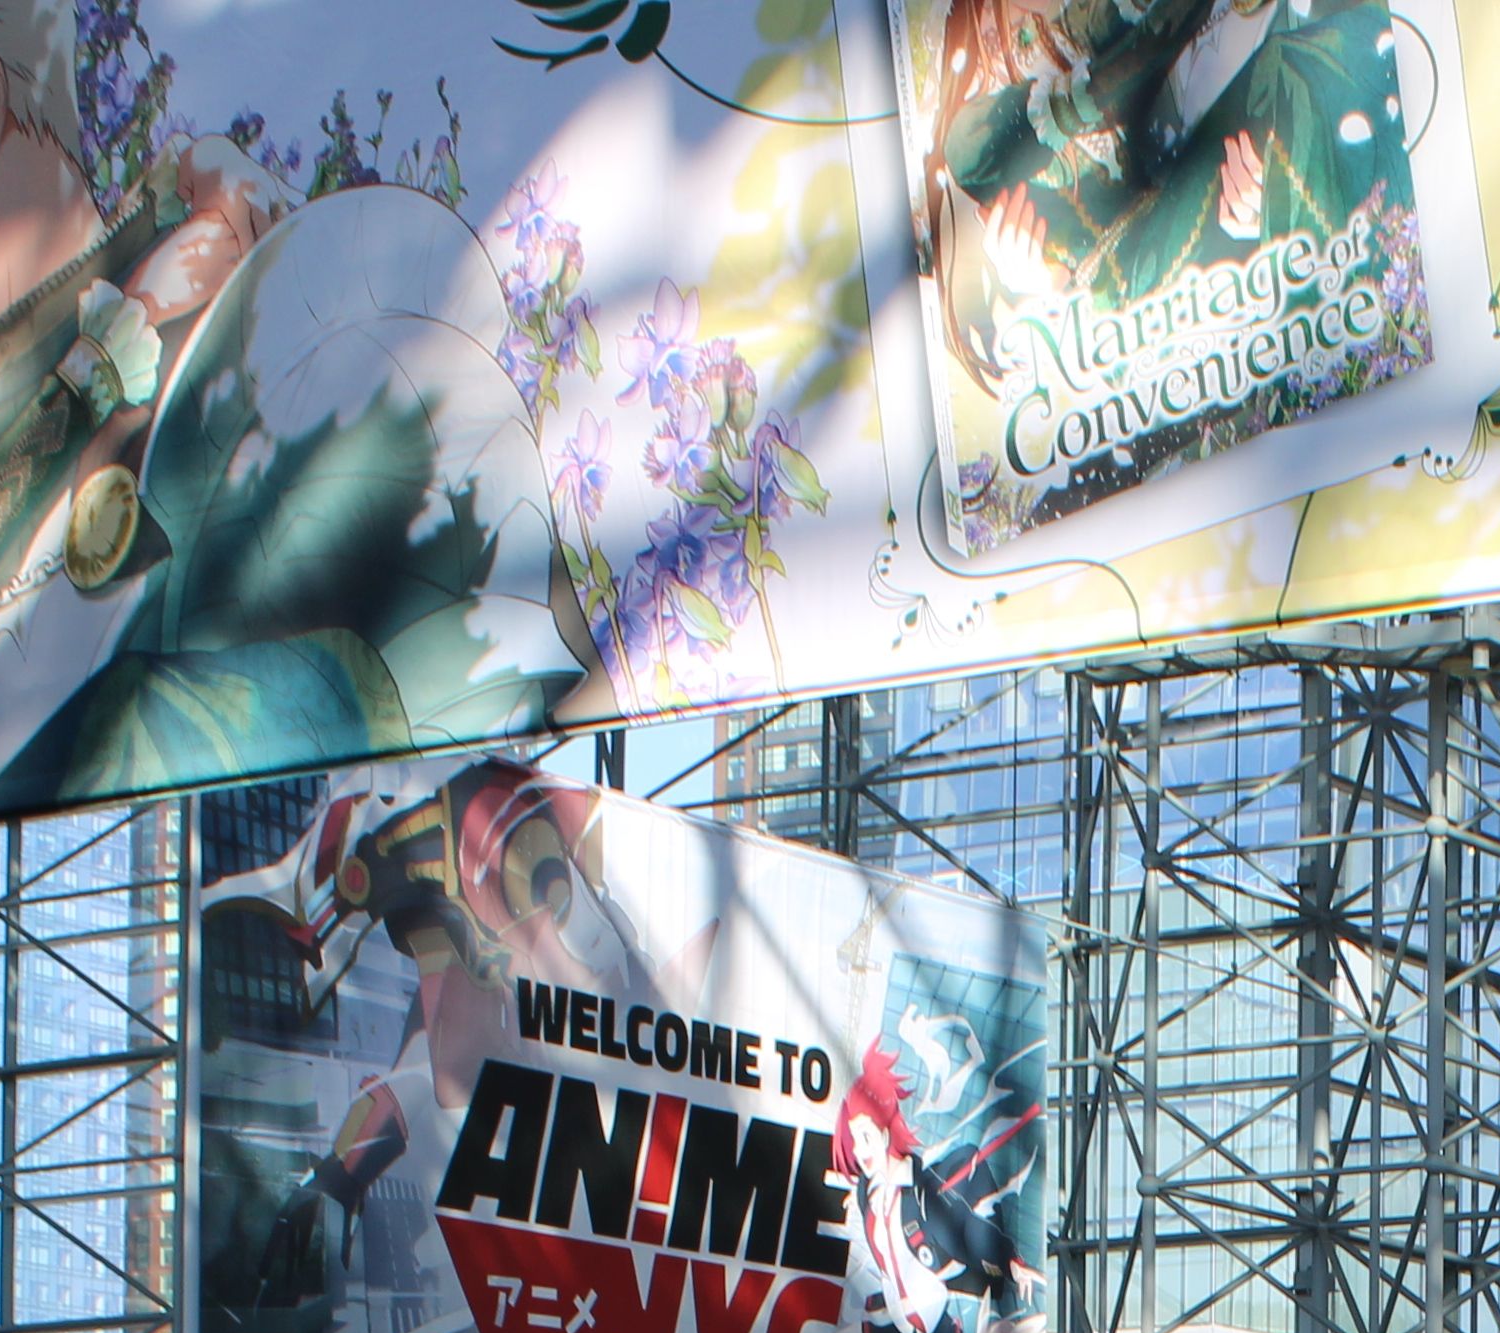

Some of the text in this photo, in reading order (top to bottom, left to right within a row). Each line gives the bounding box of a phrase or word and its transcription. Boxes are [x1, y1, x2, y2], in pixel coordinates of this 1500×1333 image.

[1000, 214, 1370, 402] Marriage of
[1004, 286, 1382, 478] Convenience
[517, 976, 832, 1103] WELCOME TO
